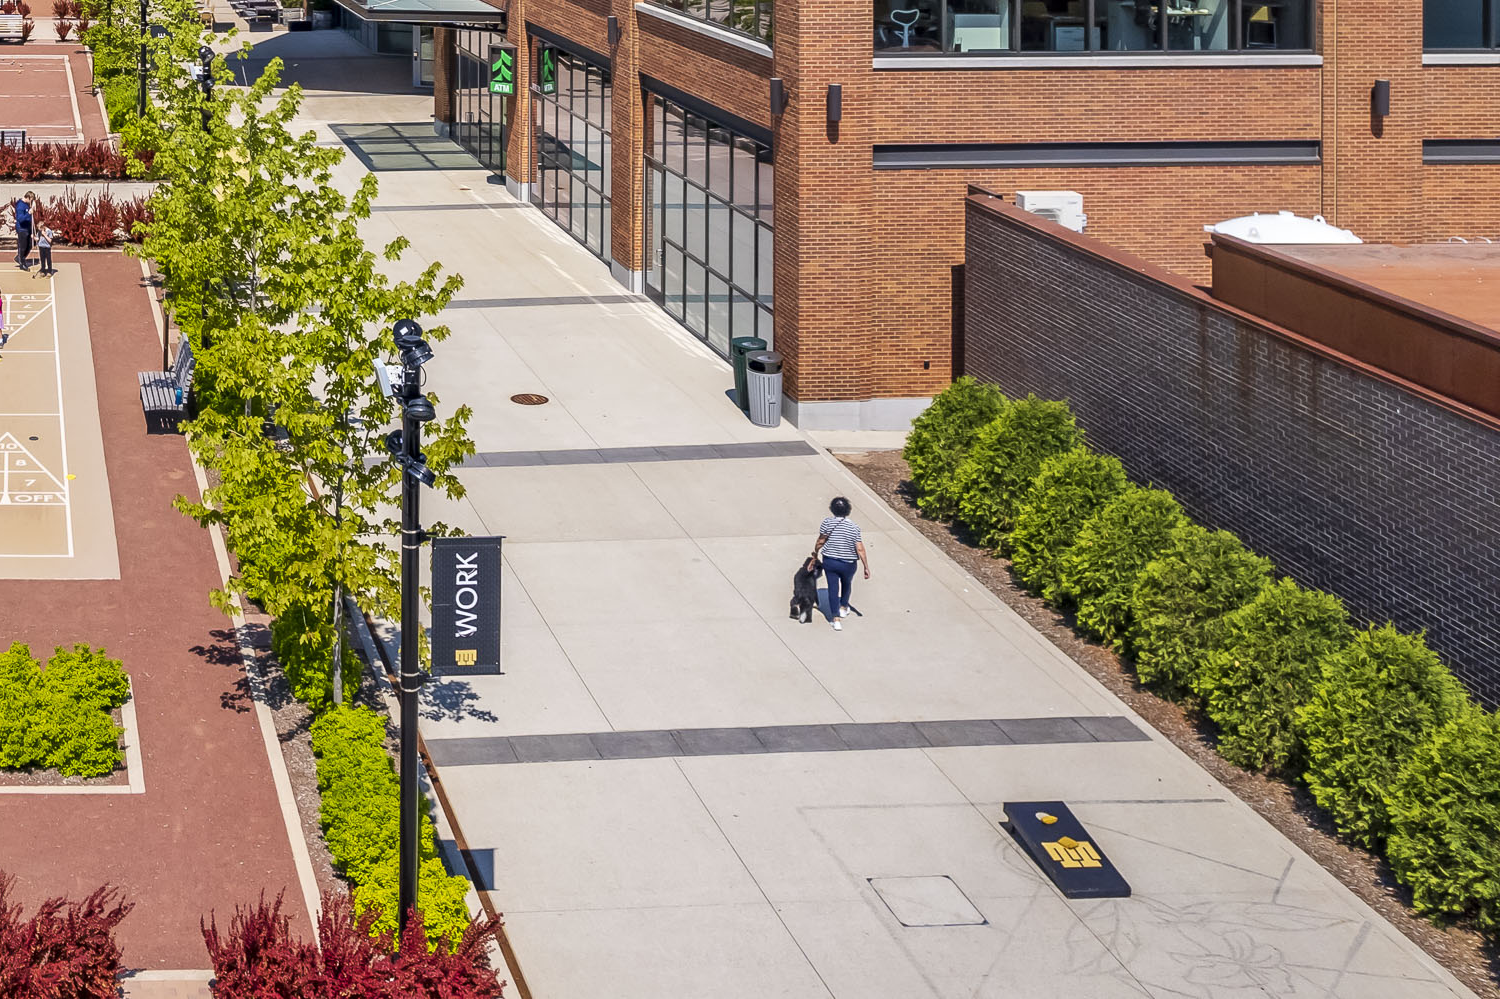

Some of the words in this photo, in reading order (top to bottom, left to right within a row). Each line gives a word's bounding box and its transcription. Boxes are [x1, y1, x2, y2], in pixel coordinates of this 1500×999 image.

[493, 83, 510, 92] ATM
[15, 494, 54, 502] OFF
[455, 552, 479, 638] WORK
